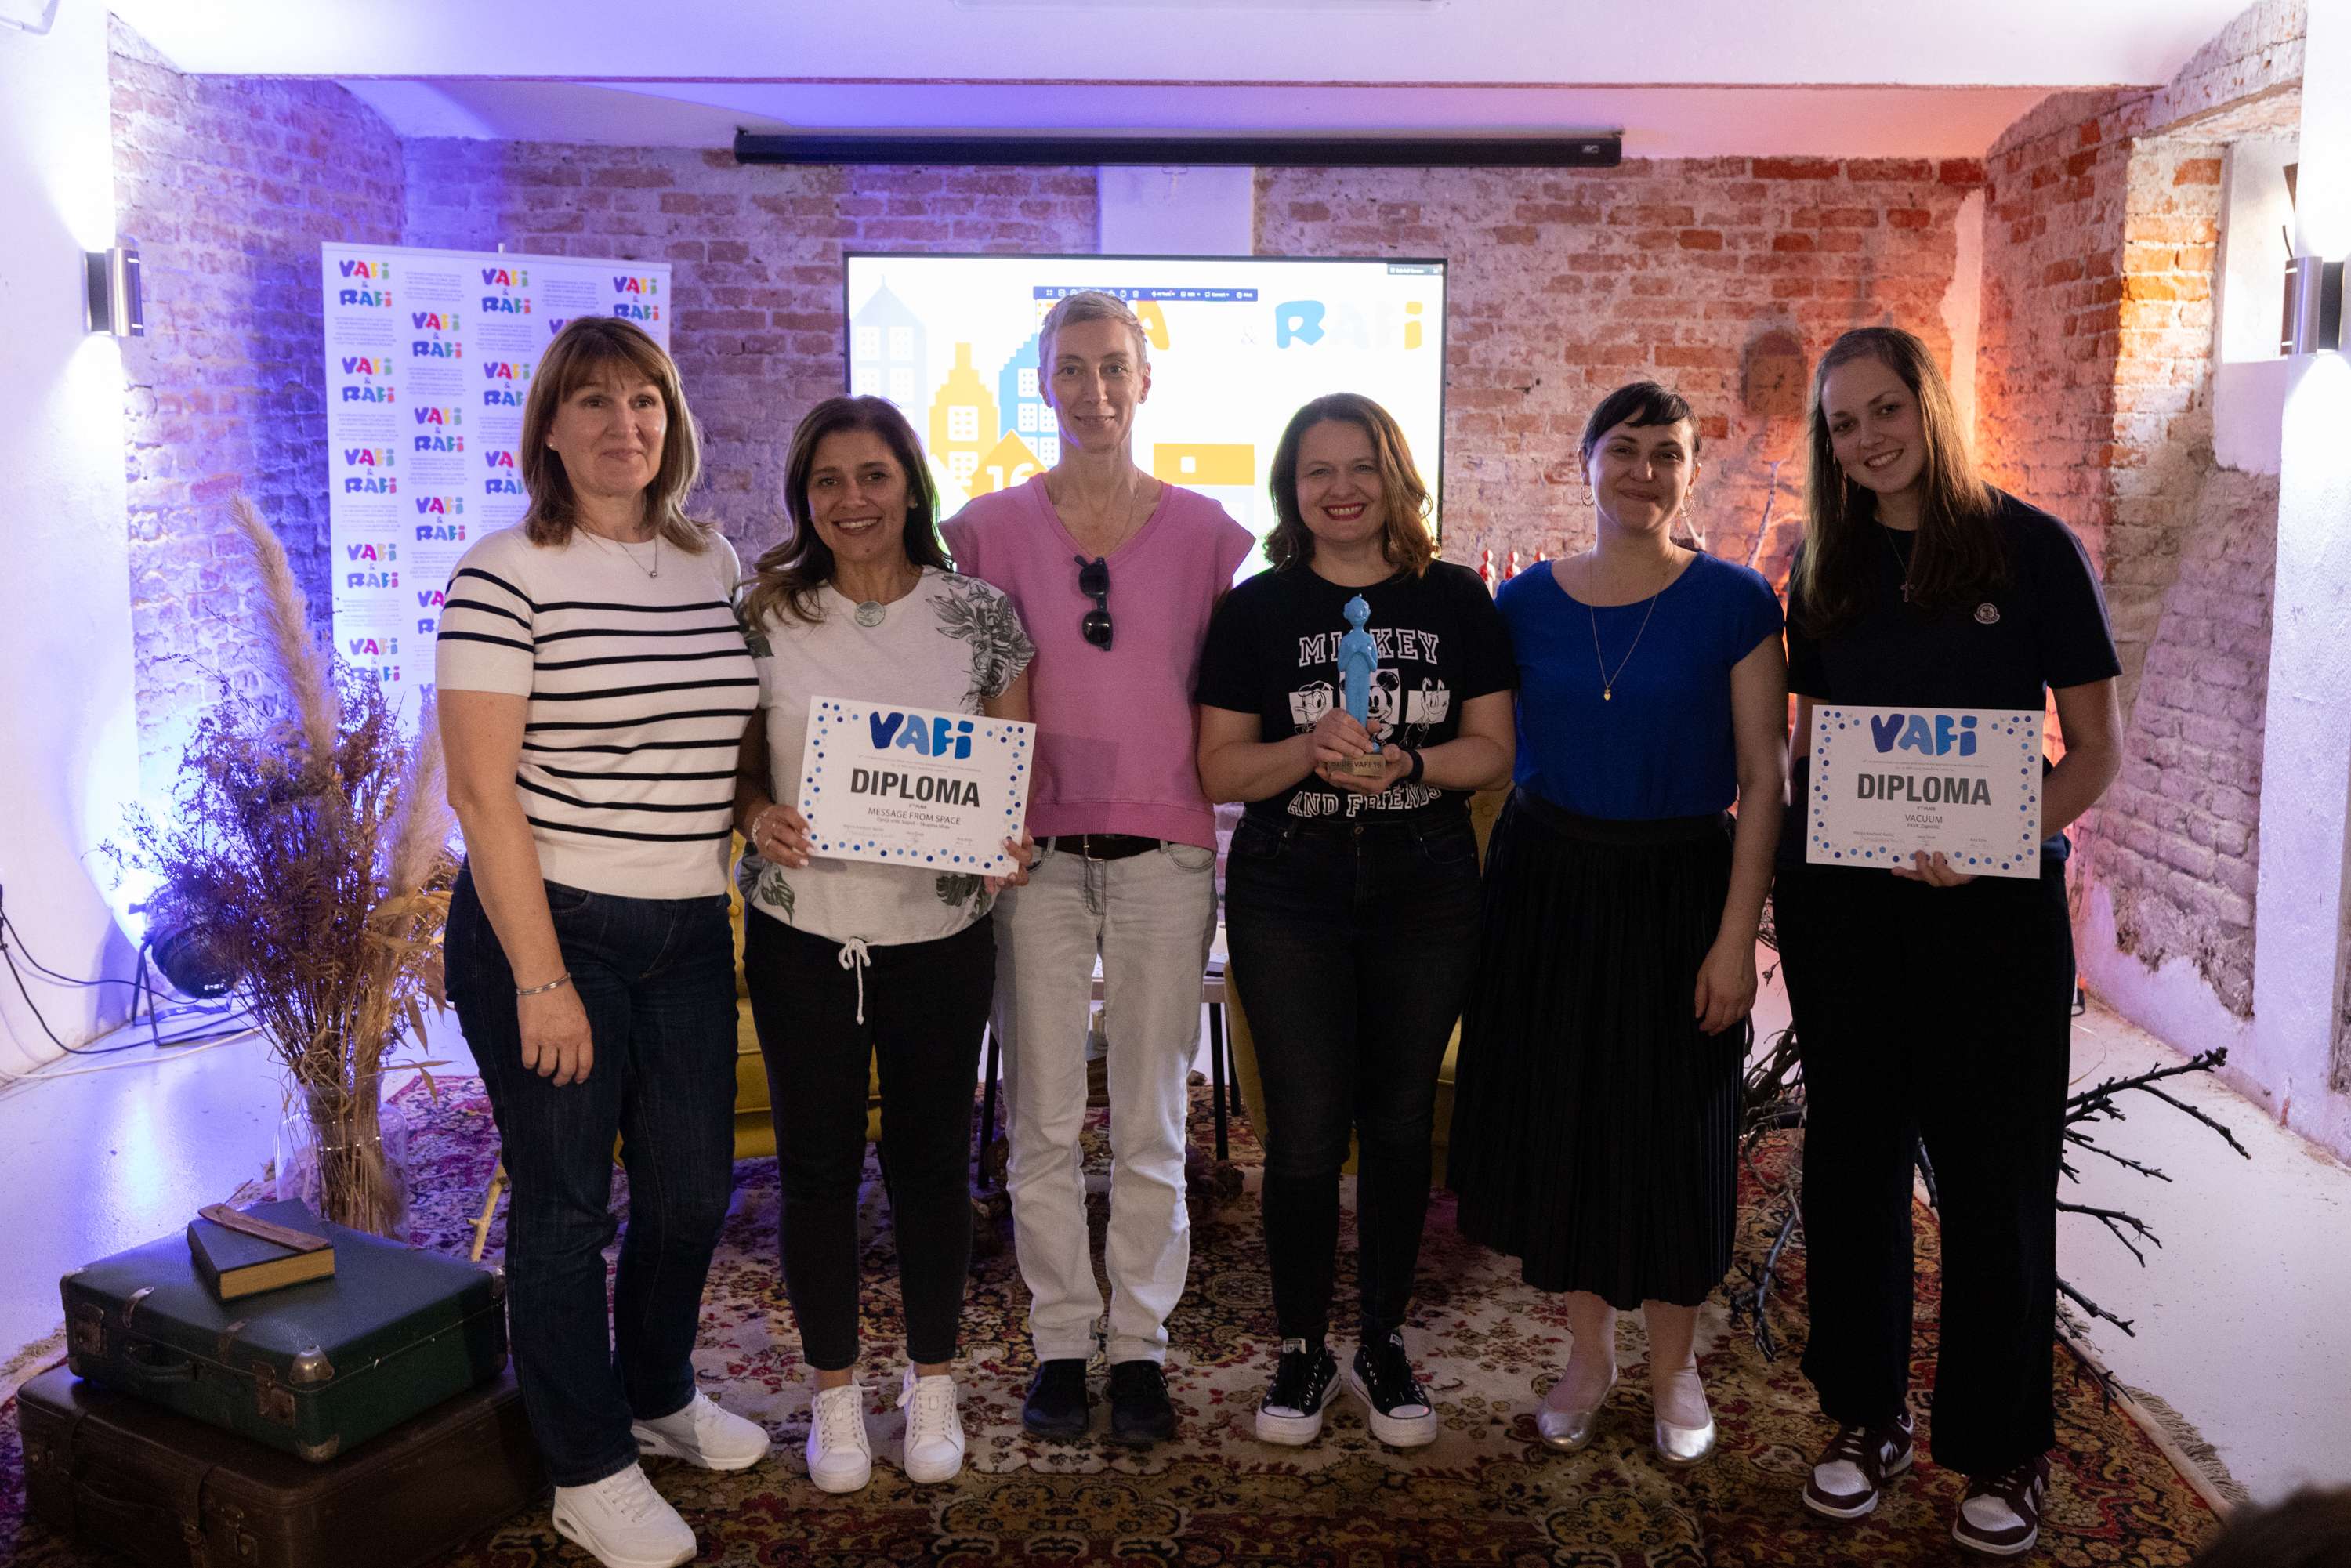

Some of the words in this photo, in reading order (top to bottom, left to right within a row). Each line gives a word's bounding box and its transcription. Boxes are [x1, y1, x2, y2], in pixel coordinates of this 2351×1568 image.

[484, 390, 525, 407] RAF
[485, 451, 521, 468] VA
[485, 479, 523, 494] RAF
[418, 590, 445, 608] VA
[1299, 628, 1440, 668] MIKEY
[869, 711, 974, 759] VAFi
[1871, 713, 1978, 756] VAFi
[850, 767, 980, 808] DIPLOMA
[1857, 773, 1991, 806] DIPLOMA
[1288, 791, 1339, 817] AND
[868, 807, 907, 820] MESSAGE
[909, 813, 933, 822] FROM
[935, 815, 961, 825] SPACE
[1905, 814, 1943, 824] VACUUM
